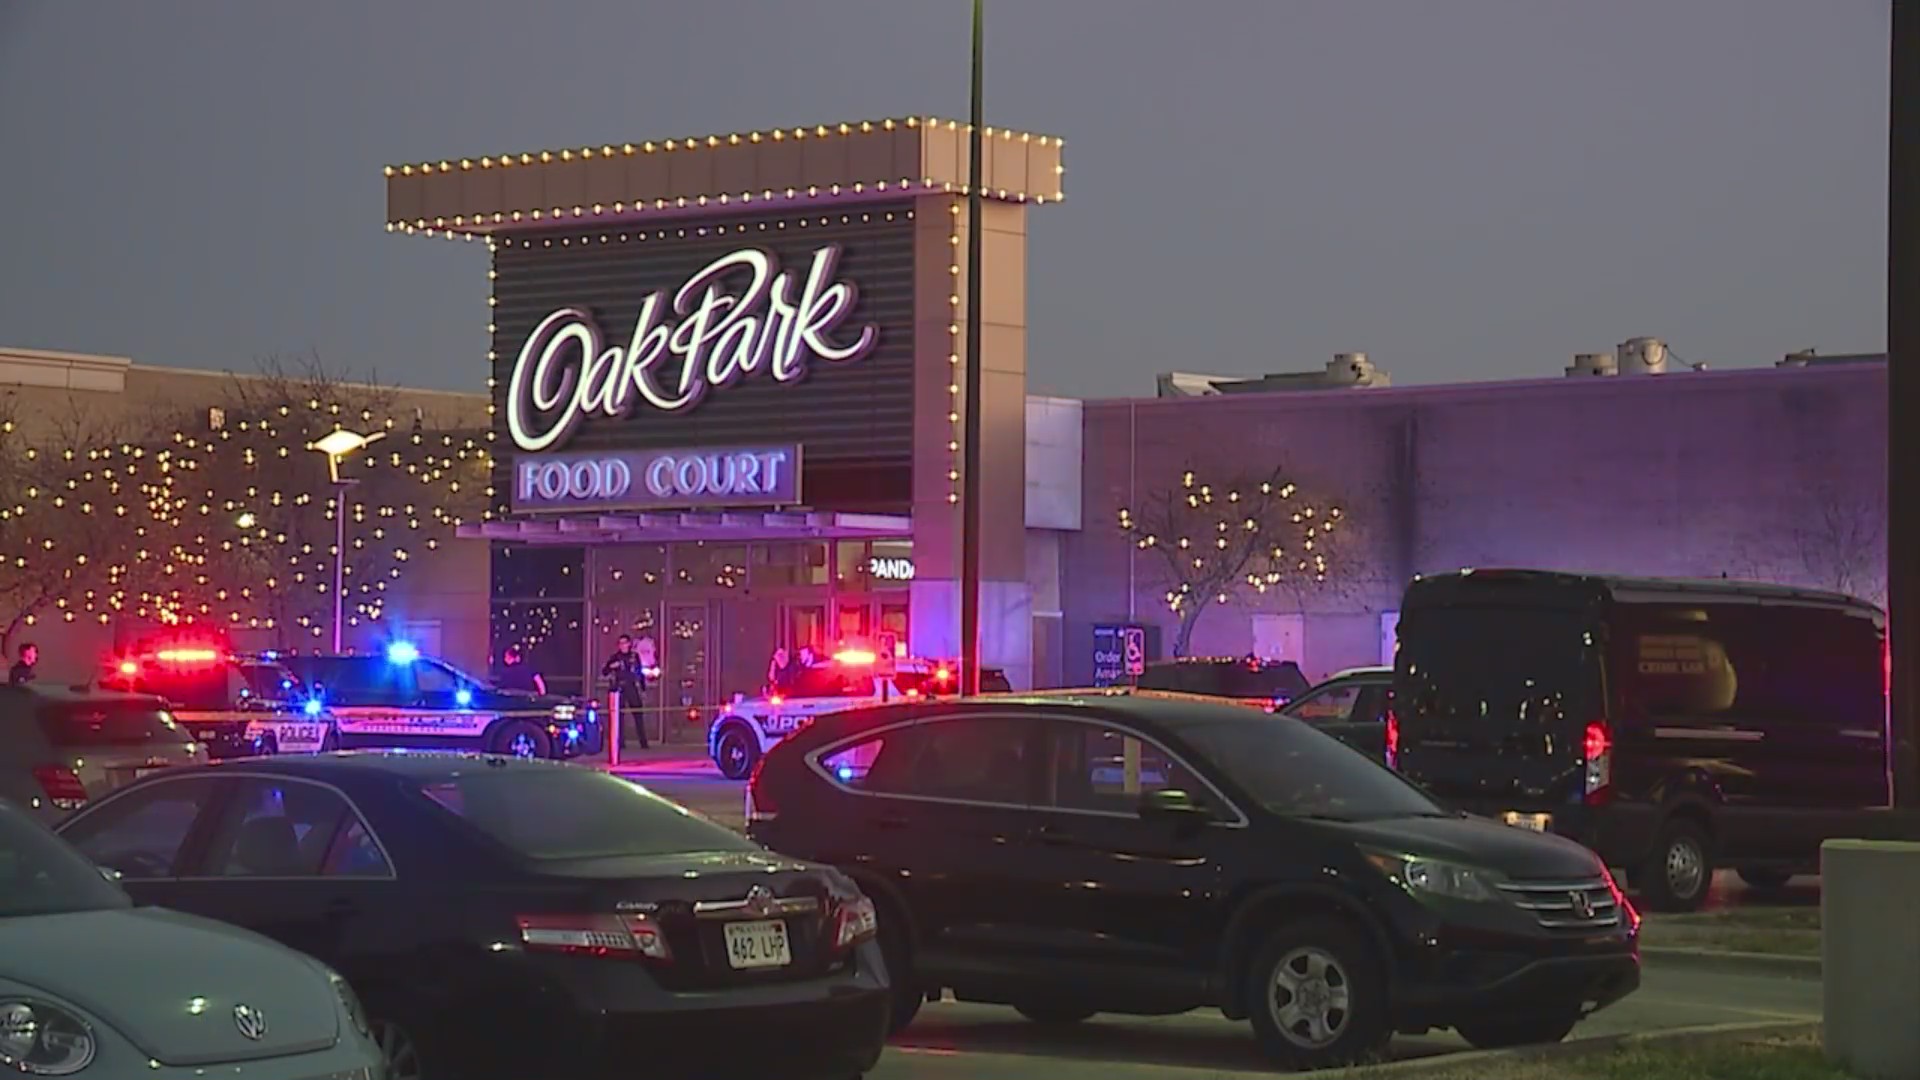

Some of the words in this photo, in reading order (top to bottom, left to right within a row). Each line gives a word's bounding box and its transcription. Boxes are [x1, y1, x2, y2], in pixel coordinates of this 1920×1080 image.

[507, 291, 702, 450] Oak
[669, 243, 880, 396] Park
[518, 457, 631, 501] FOOD
[645, 451, 786, 498] COURT
[280, 726, 320, 743] POLICE
